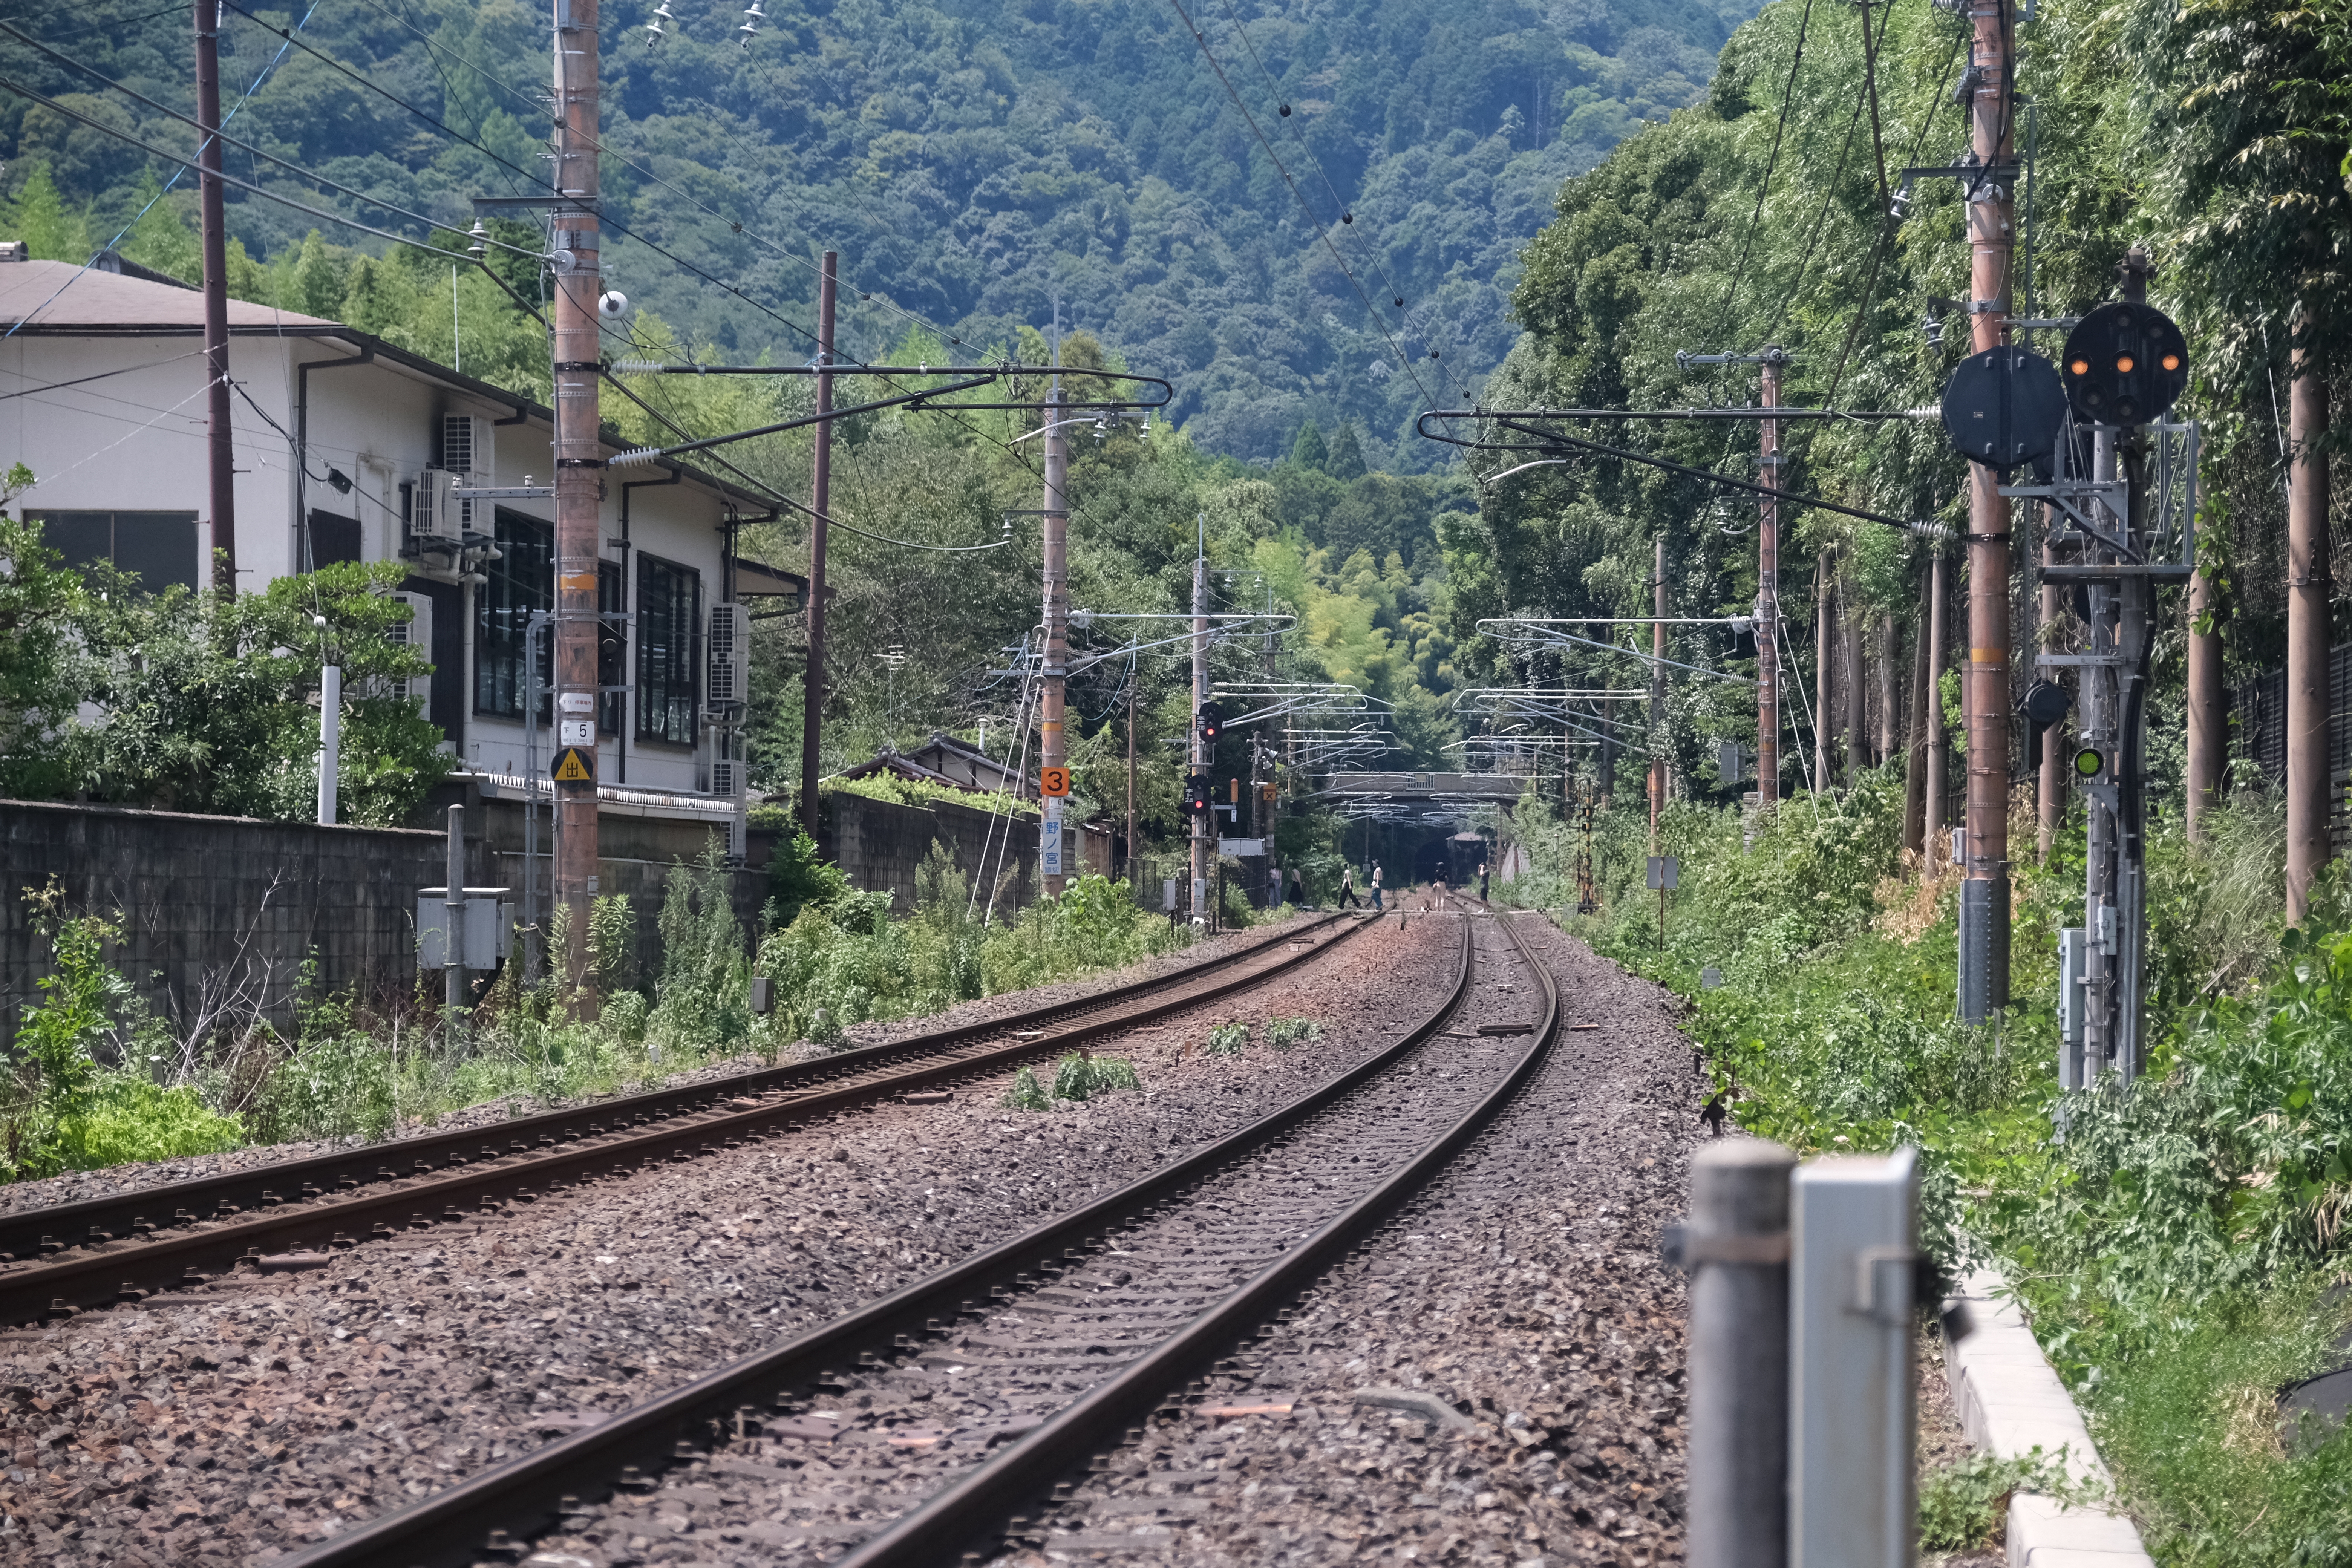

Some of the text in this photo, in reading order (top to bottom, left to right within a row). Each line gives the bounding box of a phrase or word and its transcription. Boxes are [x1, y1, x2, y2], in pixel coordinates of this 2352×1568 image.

[580, 724, 587, 737] 5
[566, 762, 578, 777] 出
[1047, 771, 1063, 791] 3
[1046, 822, 1058, 864] 野ノ宮
